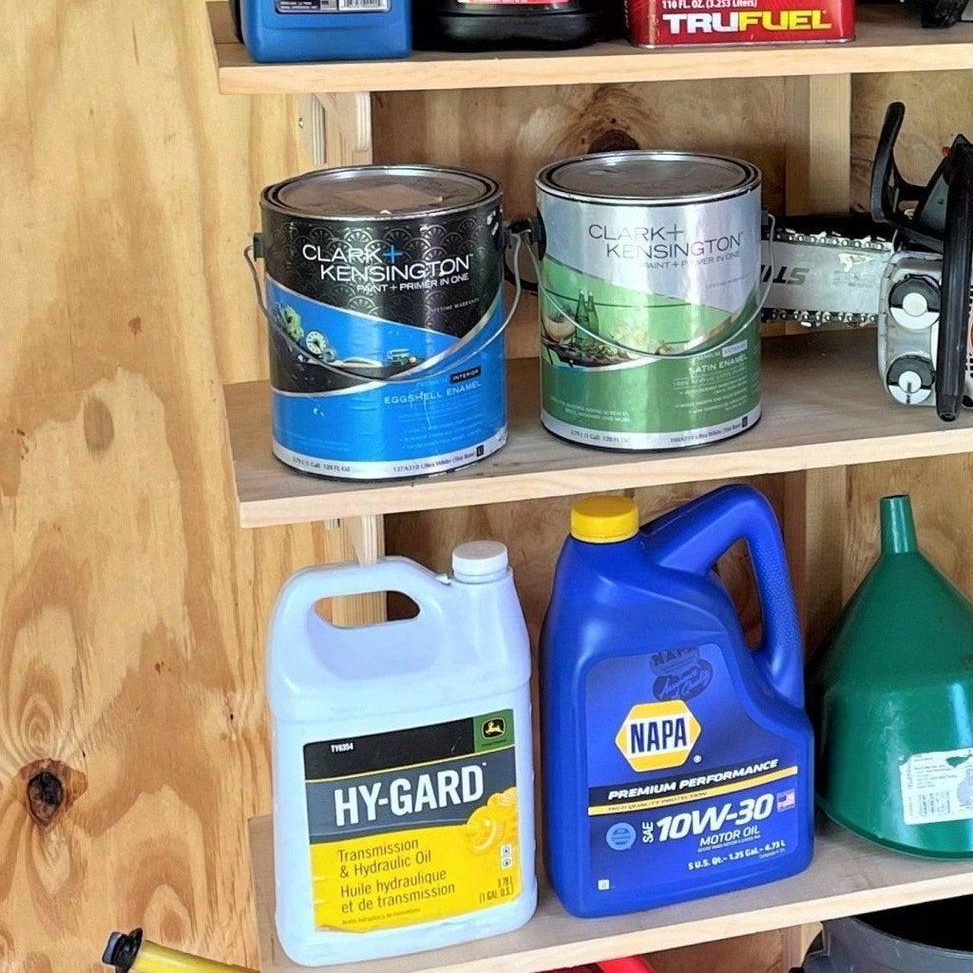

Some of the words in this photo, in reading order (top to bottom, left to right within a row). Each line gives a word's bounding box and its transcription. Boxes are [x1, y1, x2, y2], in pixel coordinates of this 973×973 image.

[662, 0, 678, 9] 110
[706, 0, 731, 9] (3.253
[662, 10, 833, 35] TRUFUEL
[606, 235, 742, 259] KENSINGTON
[320, 256, 471, 283] KENSINGTON
[356, 281, 388, 293] PAINT
[400, 279, 438, 292] PRIMER
[440, 277, 449, 289] IN
[450, 273, 470, 285] ONE
[452, 369, 480, 381] INTERIOR
[688, 363, 717, 375] SATIN
[718, 353, 748, 369] ENAMEL
[384, 391, 443, 405] EGGSHELL
[446, 381, 482, 397] ENAMEL
[630, 717, 688, 755] NAPA
[608, 782, 676, 801] PREMIUM
[679, 758, 780, 790] PERFORMANCE
[334, 765, 484, 827] HY-GARD
[642, 821, 654, 844] SAE
[656, 793, 775, 842] 10W-30
[700, 831, 741, 847] MOTOR
[742, 827, 760, 838] OIL
[338, 839, 419, 863] Transmission
[696, 859, 711, 869] U.S.
[729, 851, 744, 861] 1.25
[765, 841, 780, 852] 4.73
[340, 866, 350, 878] &
[354, 856, 412, 877] Hydraulic
[416, 851, 432, 865] Oil
[341, 883, 372, 898] Huile
[376, 869, 447, 894] hydraulique
[342, 902, 354, 914] et
[358, 898, 374, 911] de
[378, 883, 456, 909] transmission
